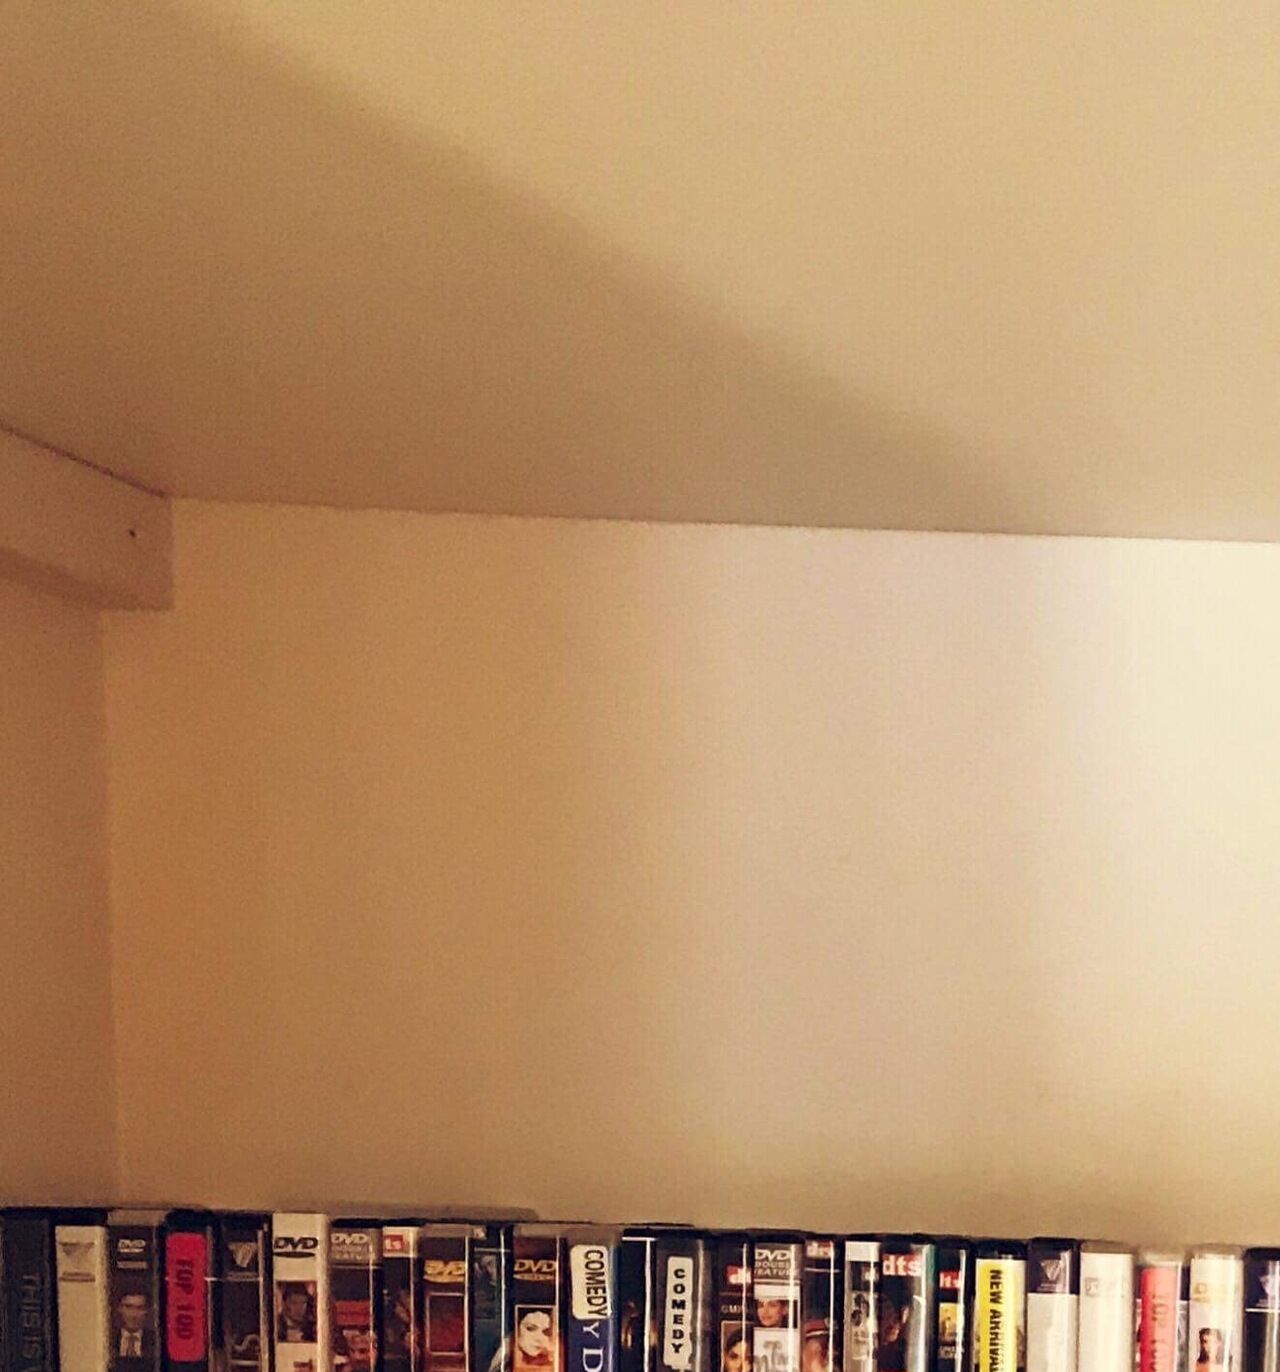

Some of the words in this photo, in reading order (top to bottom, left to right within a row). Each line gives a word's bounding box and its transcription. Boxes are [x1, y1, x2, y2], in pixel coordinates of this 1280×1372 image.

[274, 1237, 318, 1251] DVD
[754, 1249, 793, 1260] DVD
[175, 1258, 195, 1296] TOP
[513, 1259, 556, 1273] DVD
[881, 1254, 922, 1277] dts
[22, 1271, 41, 1328] THIS
[583, 1249, 609, 1320] COMEDY
[989, 1269, 1004, 1305] NEW
[175, 1301, 195, 1341] 100
[671, 1267, 687, 1354] COMEDY
[22, 1337, 41, 1362] IS
